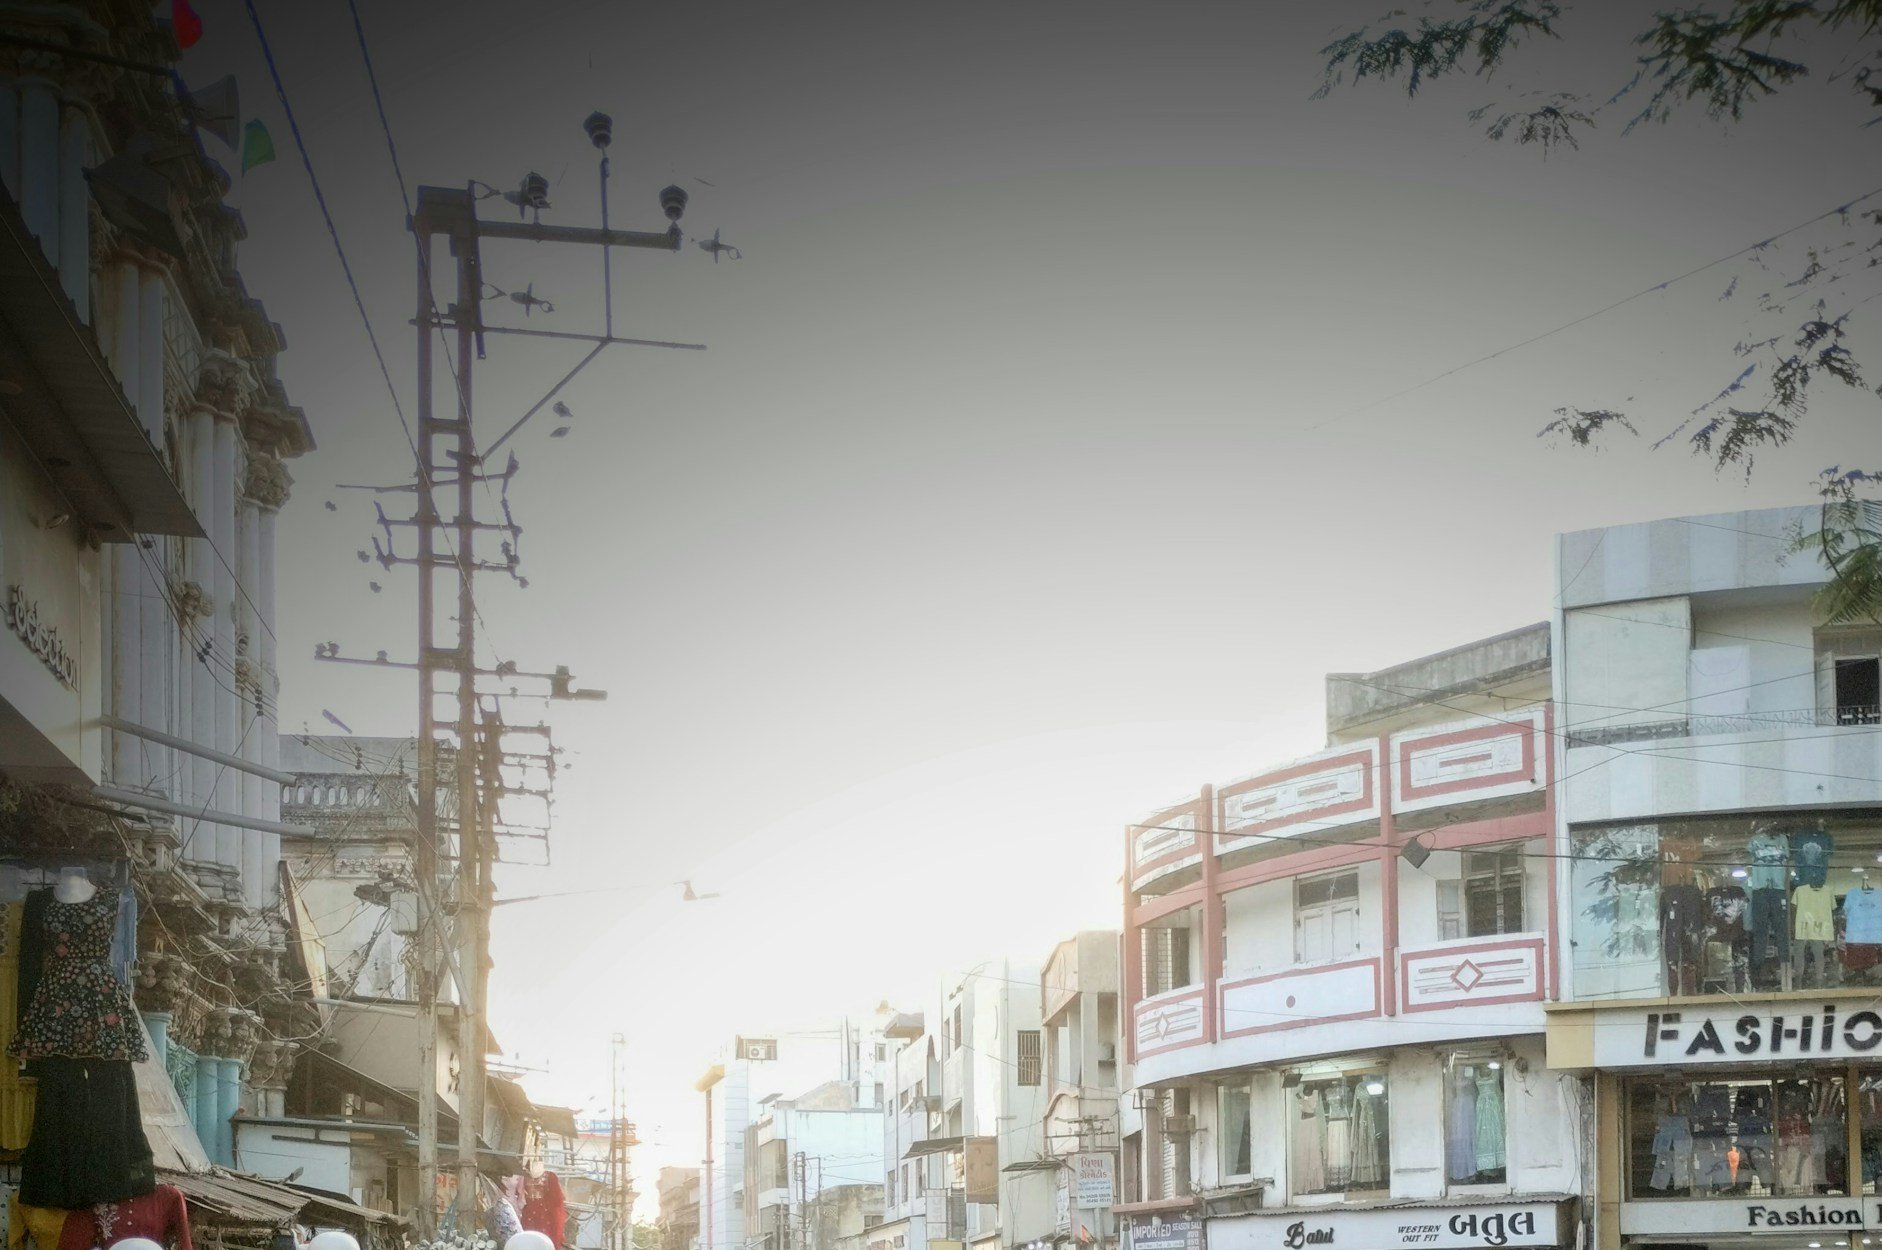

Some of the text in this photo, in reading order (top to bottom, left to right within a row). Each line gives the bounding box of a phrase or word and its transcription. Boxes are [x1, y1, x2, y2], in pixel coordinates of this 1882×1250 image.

[1747, 1205, 1863, 1226] Fashion
[1133, 1223, 1172, 1239] IMPORTED
[1172, 1222, 1190, 1232] SEASON
[1398, 1224, 1442, 1234] WESTERN
[1449, 1212, 1536, 1246] બતુલ
[1402, 1233, 1440, 1243] OUT FIT
